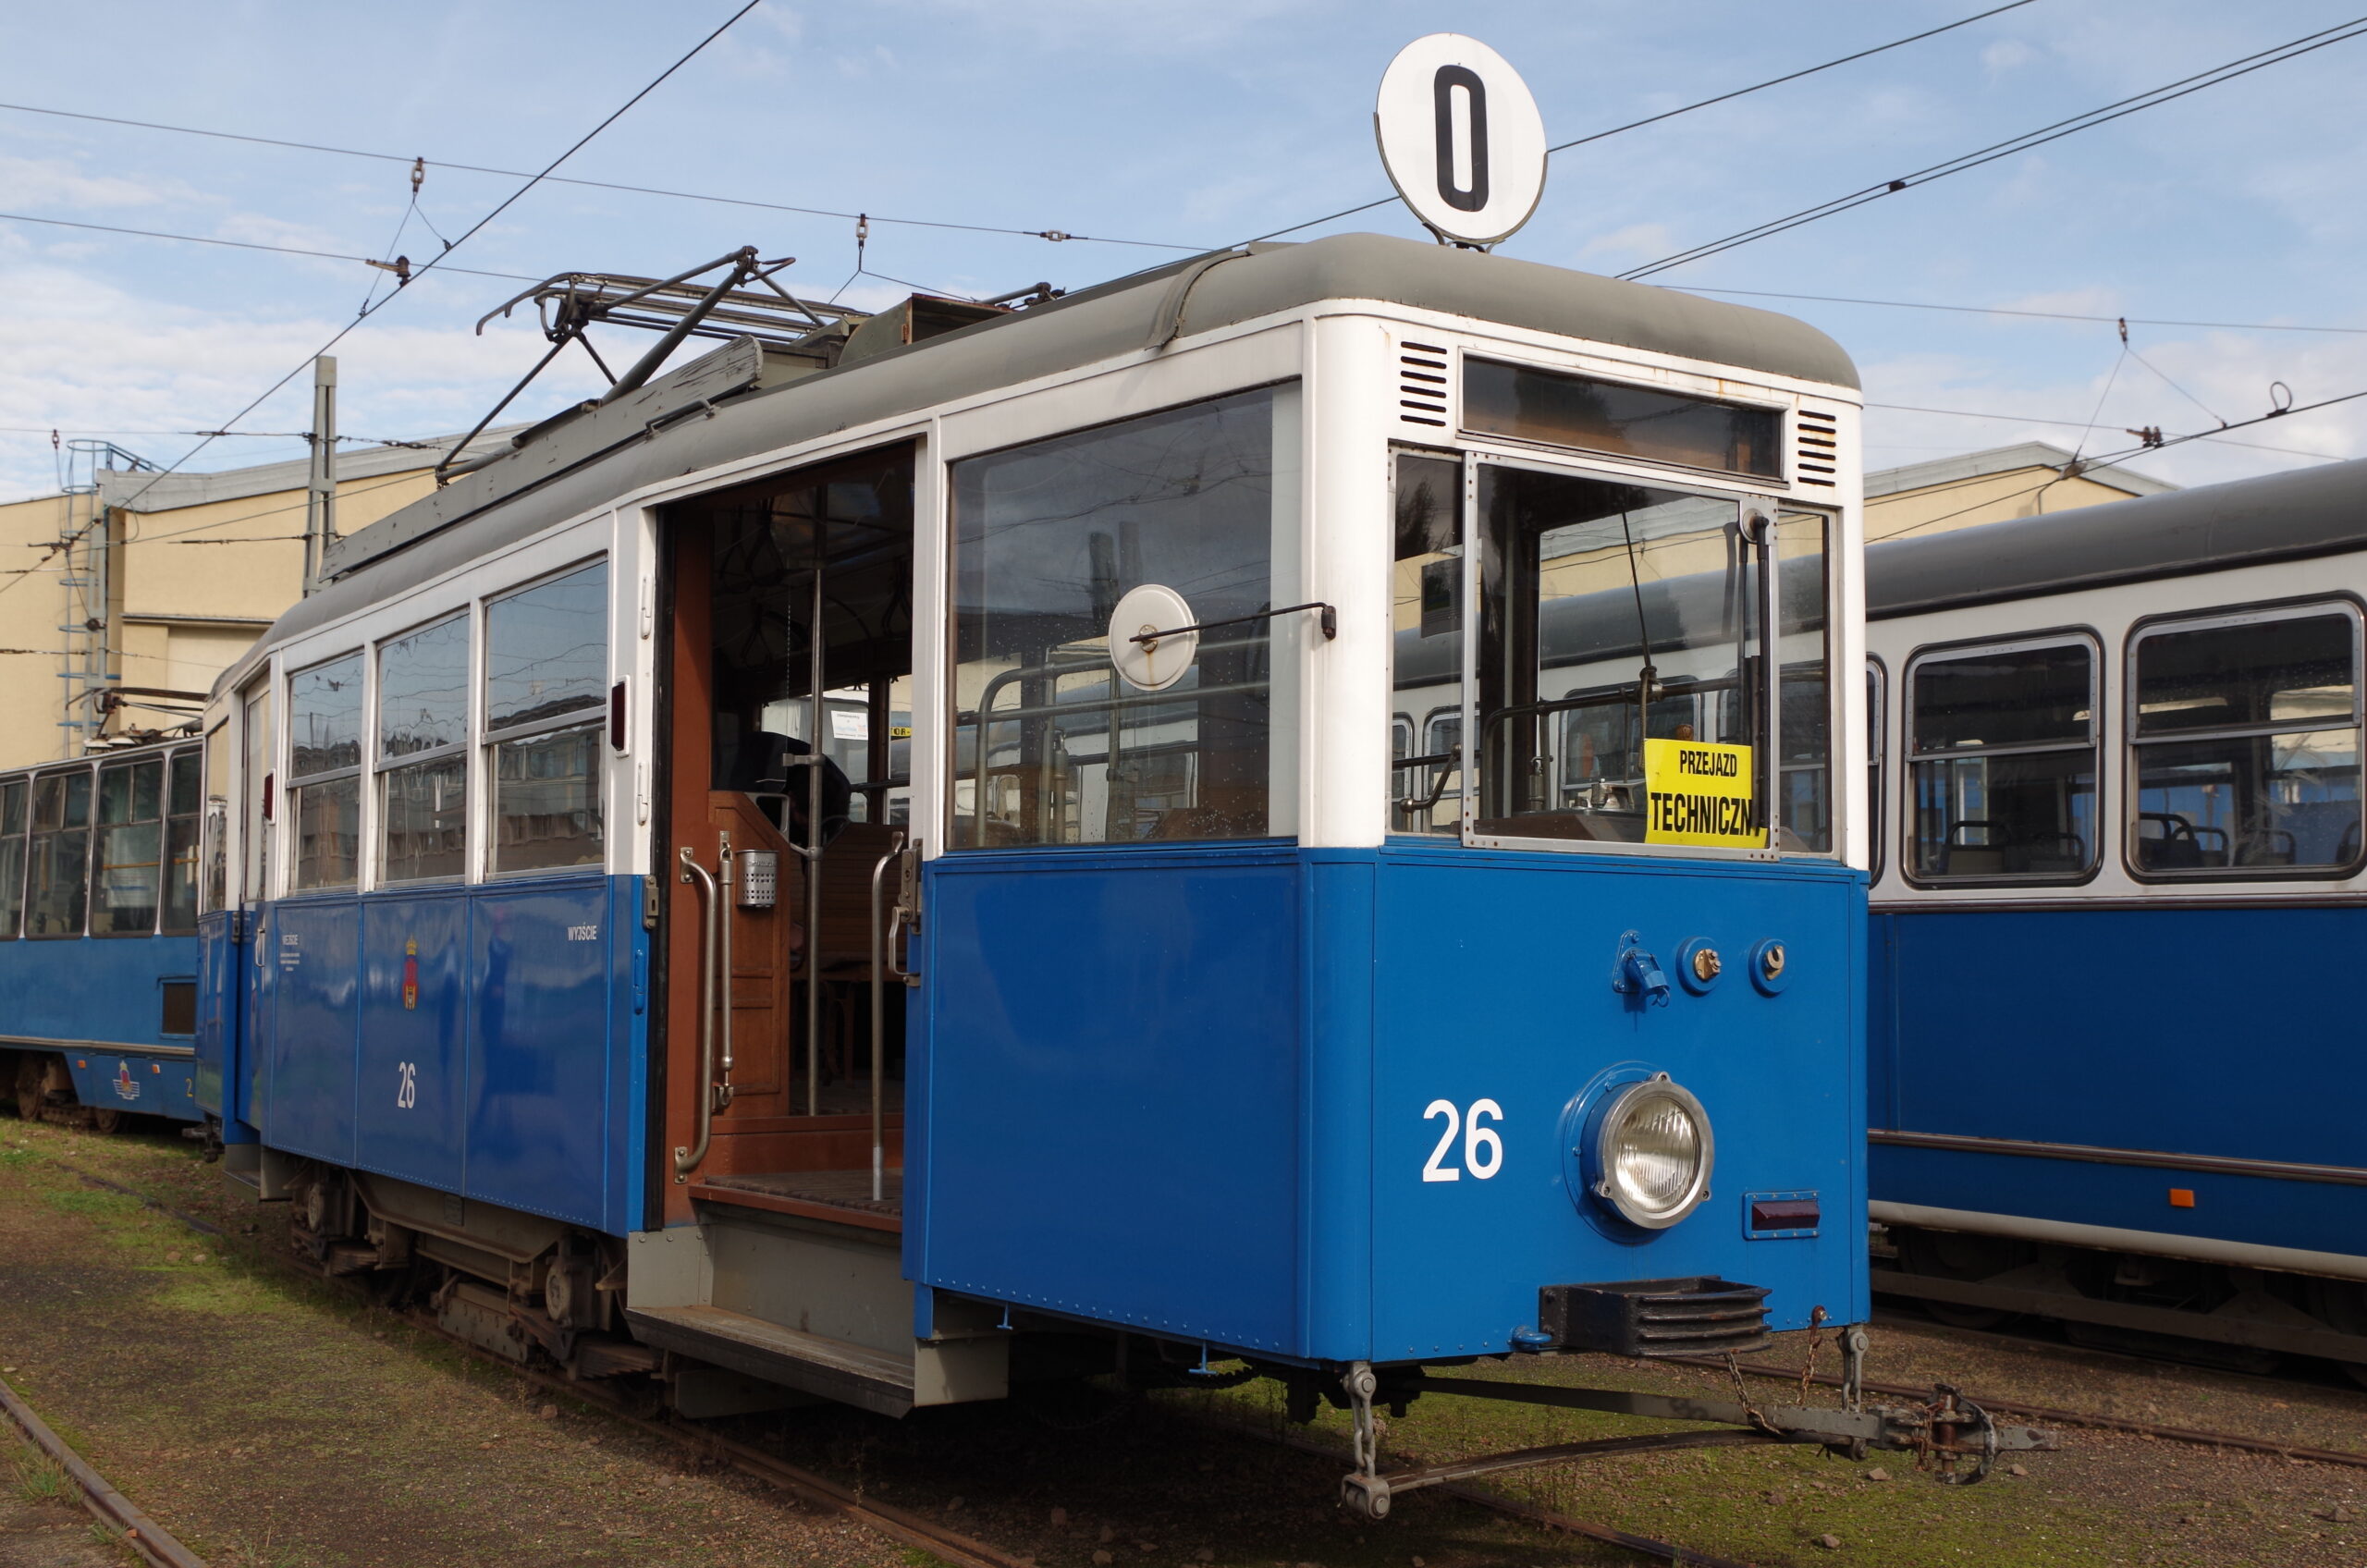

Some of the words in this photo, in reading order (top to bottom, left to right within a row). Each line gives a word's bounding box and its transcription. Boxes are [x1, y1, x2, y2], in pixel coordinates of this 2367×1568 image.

[1680, 750, 1737, 778] PRZEJAZD
[1650, 791, 1760, 837] TECHNICZN
[568, 921, 597, 941] WYJŚCIE
[398, 1061, 415, 1109] 26
[1422, 1097, 1503, 1182] 26
